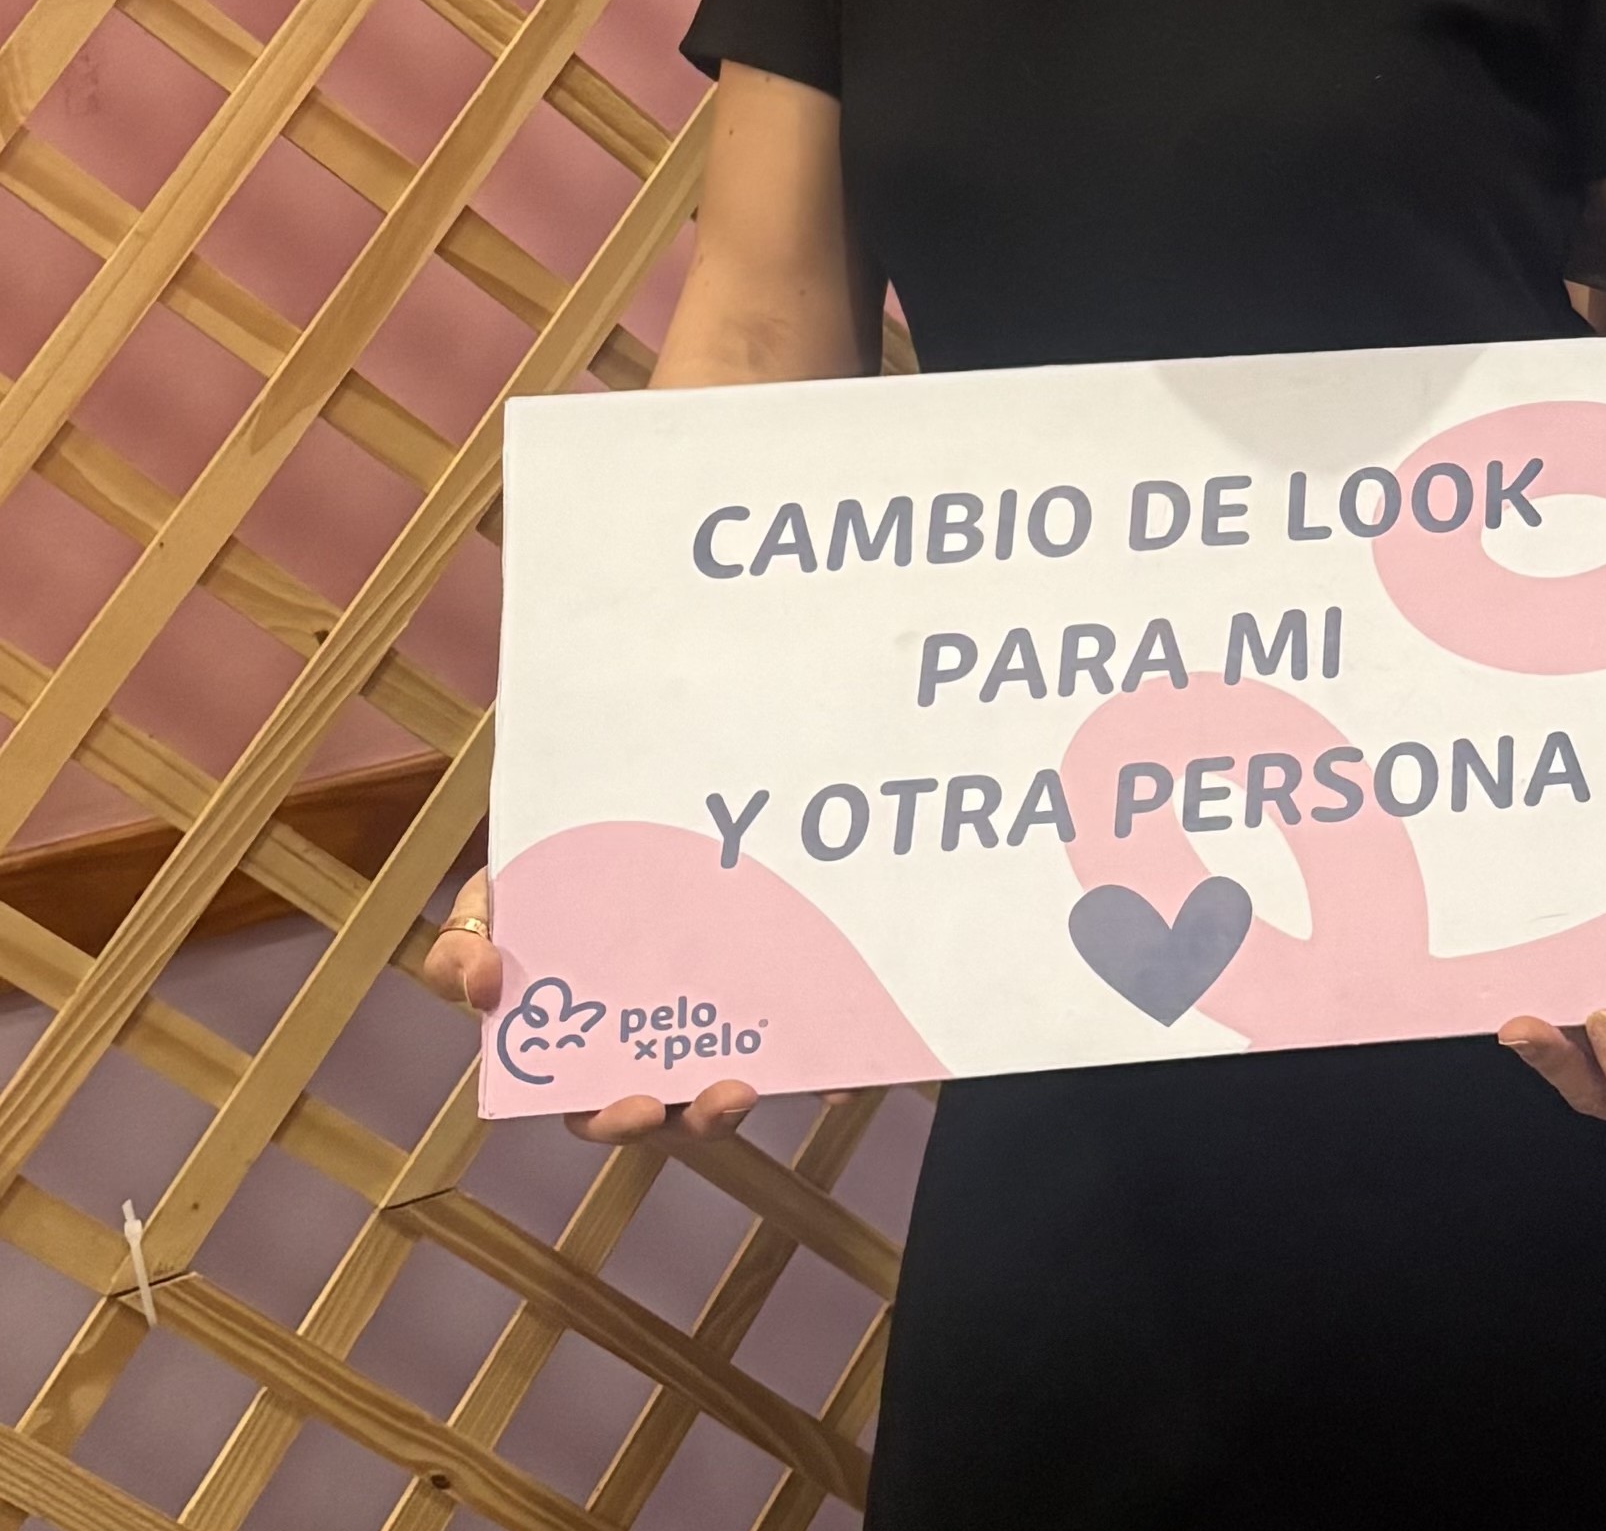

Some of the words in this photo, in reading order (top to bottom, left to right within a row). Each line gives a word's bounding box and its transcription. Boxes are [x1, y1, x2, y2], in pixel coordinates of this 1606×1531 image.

[692, 485, 1093, 580] CAMBIO
[1128, 474, 1254, 552] DE
[1286, 457, 1544, 541] LOOK
[917, 616, 1189, 708] PARA
[1223, 606, 1343, 686] MI
[705, 789, 770, 870] Y
[800, 768, 1077, 862] OTRA
[1113, 730, 1592, 839] PERSONA
[620, 995, 718, 1043] pelo
